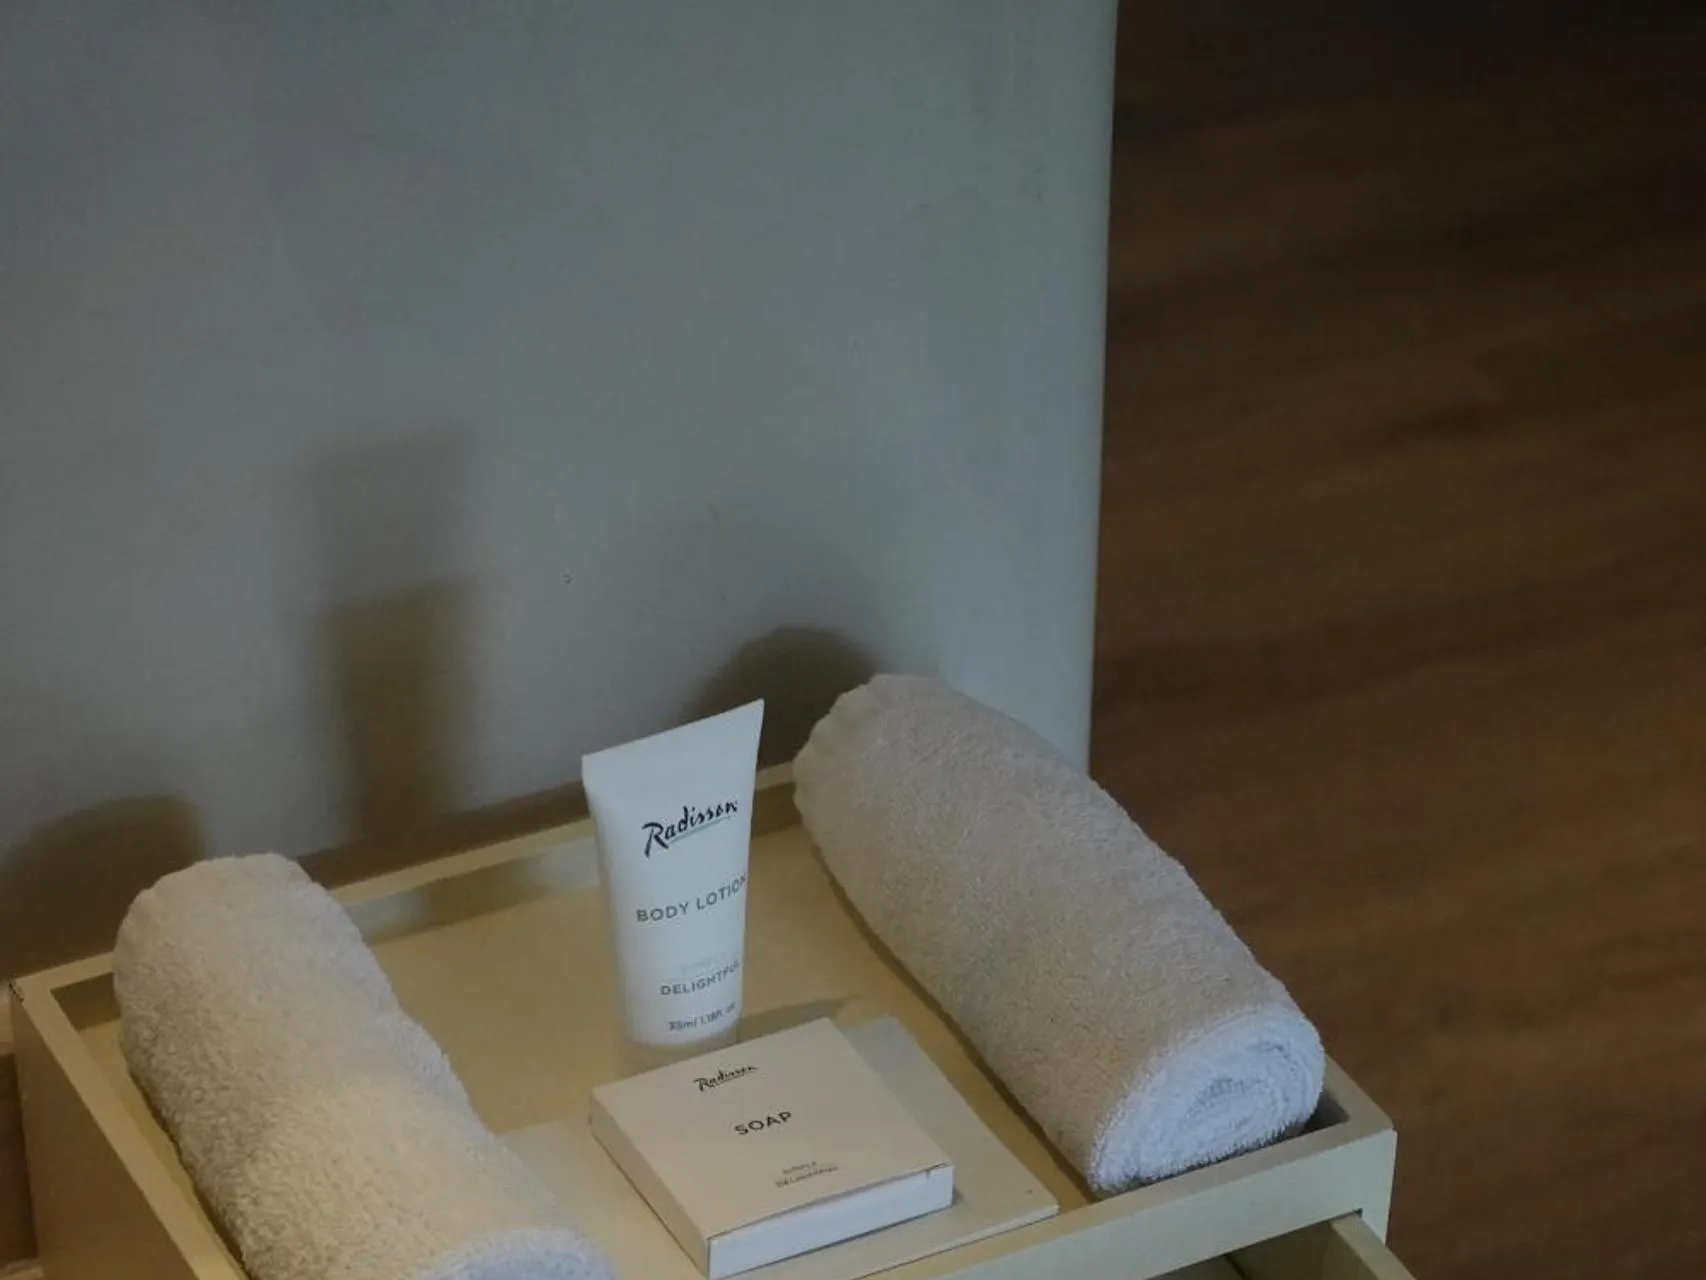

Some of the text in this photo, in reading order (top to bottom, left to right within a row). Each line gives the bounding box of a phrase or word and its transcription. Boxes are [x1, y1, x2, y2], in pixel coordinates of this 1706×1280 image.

[641, 799, 739, 858] Radisson
[636, 901, 689, 922] BODY
[693, 1065, 758, 1093] Radisson
[733, 1110, 792, 1136] SOAP
